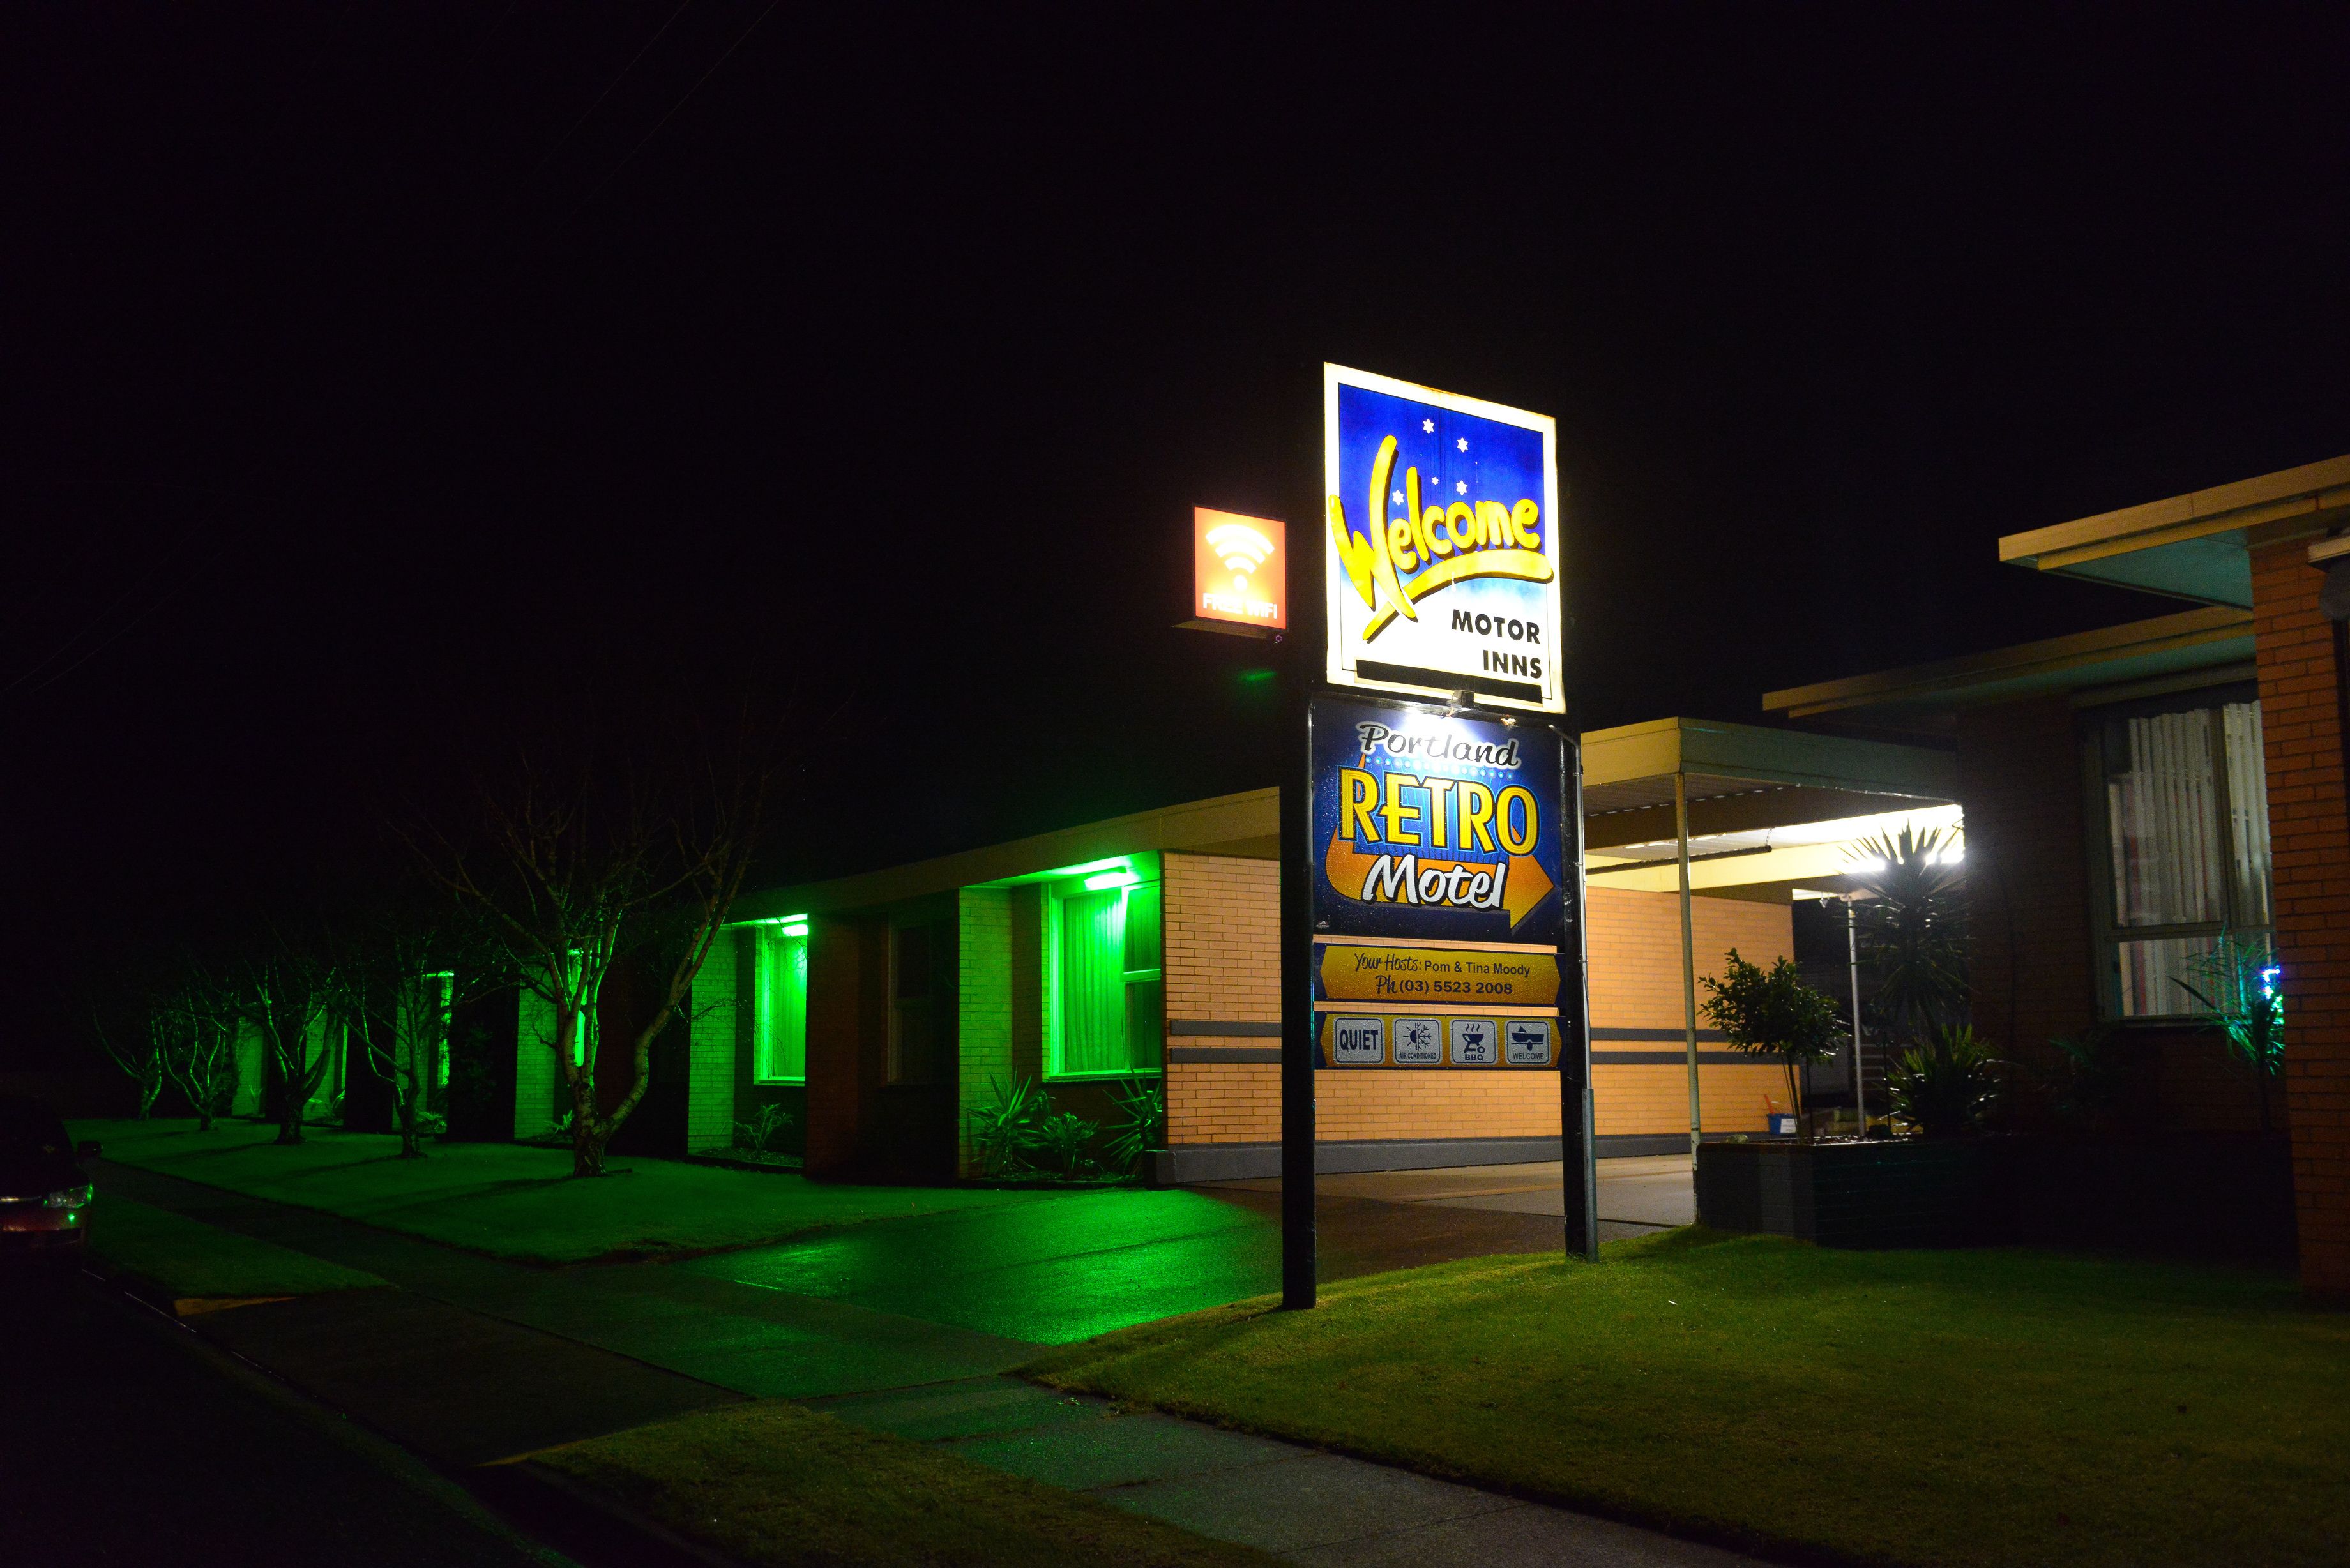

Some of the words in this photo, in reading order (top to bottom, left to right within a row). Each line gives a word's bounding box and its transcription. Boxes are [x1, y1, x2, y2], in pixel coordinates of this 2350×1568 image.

[1328, 435, 1542, 622] Welcome
[1203, 592, 1243, 614] FREE
[1452, 609, 1540, 644] MOTOR
[1483, 649, 1542, 679] INNS
[1357, 723, 1520, 766] Portland
[1338, 766, 1540, 856] RETRO
[1362, 854, 1507, 909] Motel
[1354, 952, 1383, 972] Your
[1384, 953, 1421, 971] Hosts:
[1424, 960, 1450, 972] Pom
[1454, 961, 1462, 972] &
[1466, 962, 1489, 974] Tina
[1494, 963, 1530, 978] Moody
[1376, 975, 1397, 994] Ph
[1400, 980, 1429, 994] (03)
[1434, 981, 1471, 993] 5523
[1476, 982, 1513, 995] 2008
[1339, 1029, 1378, 1052] QUIET
